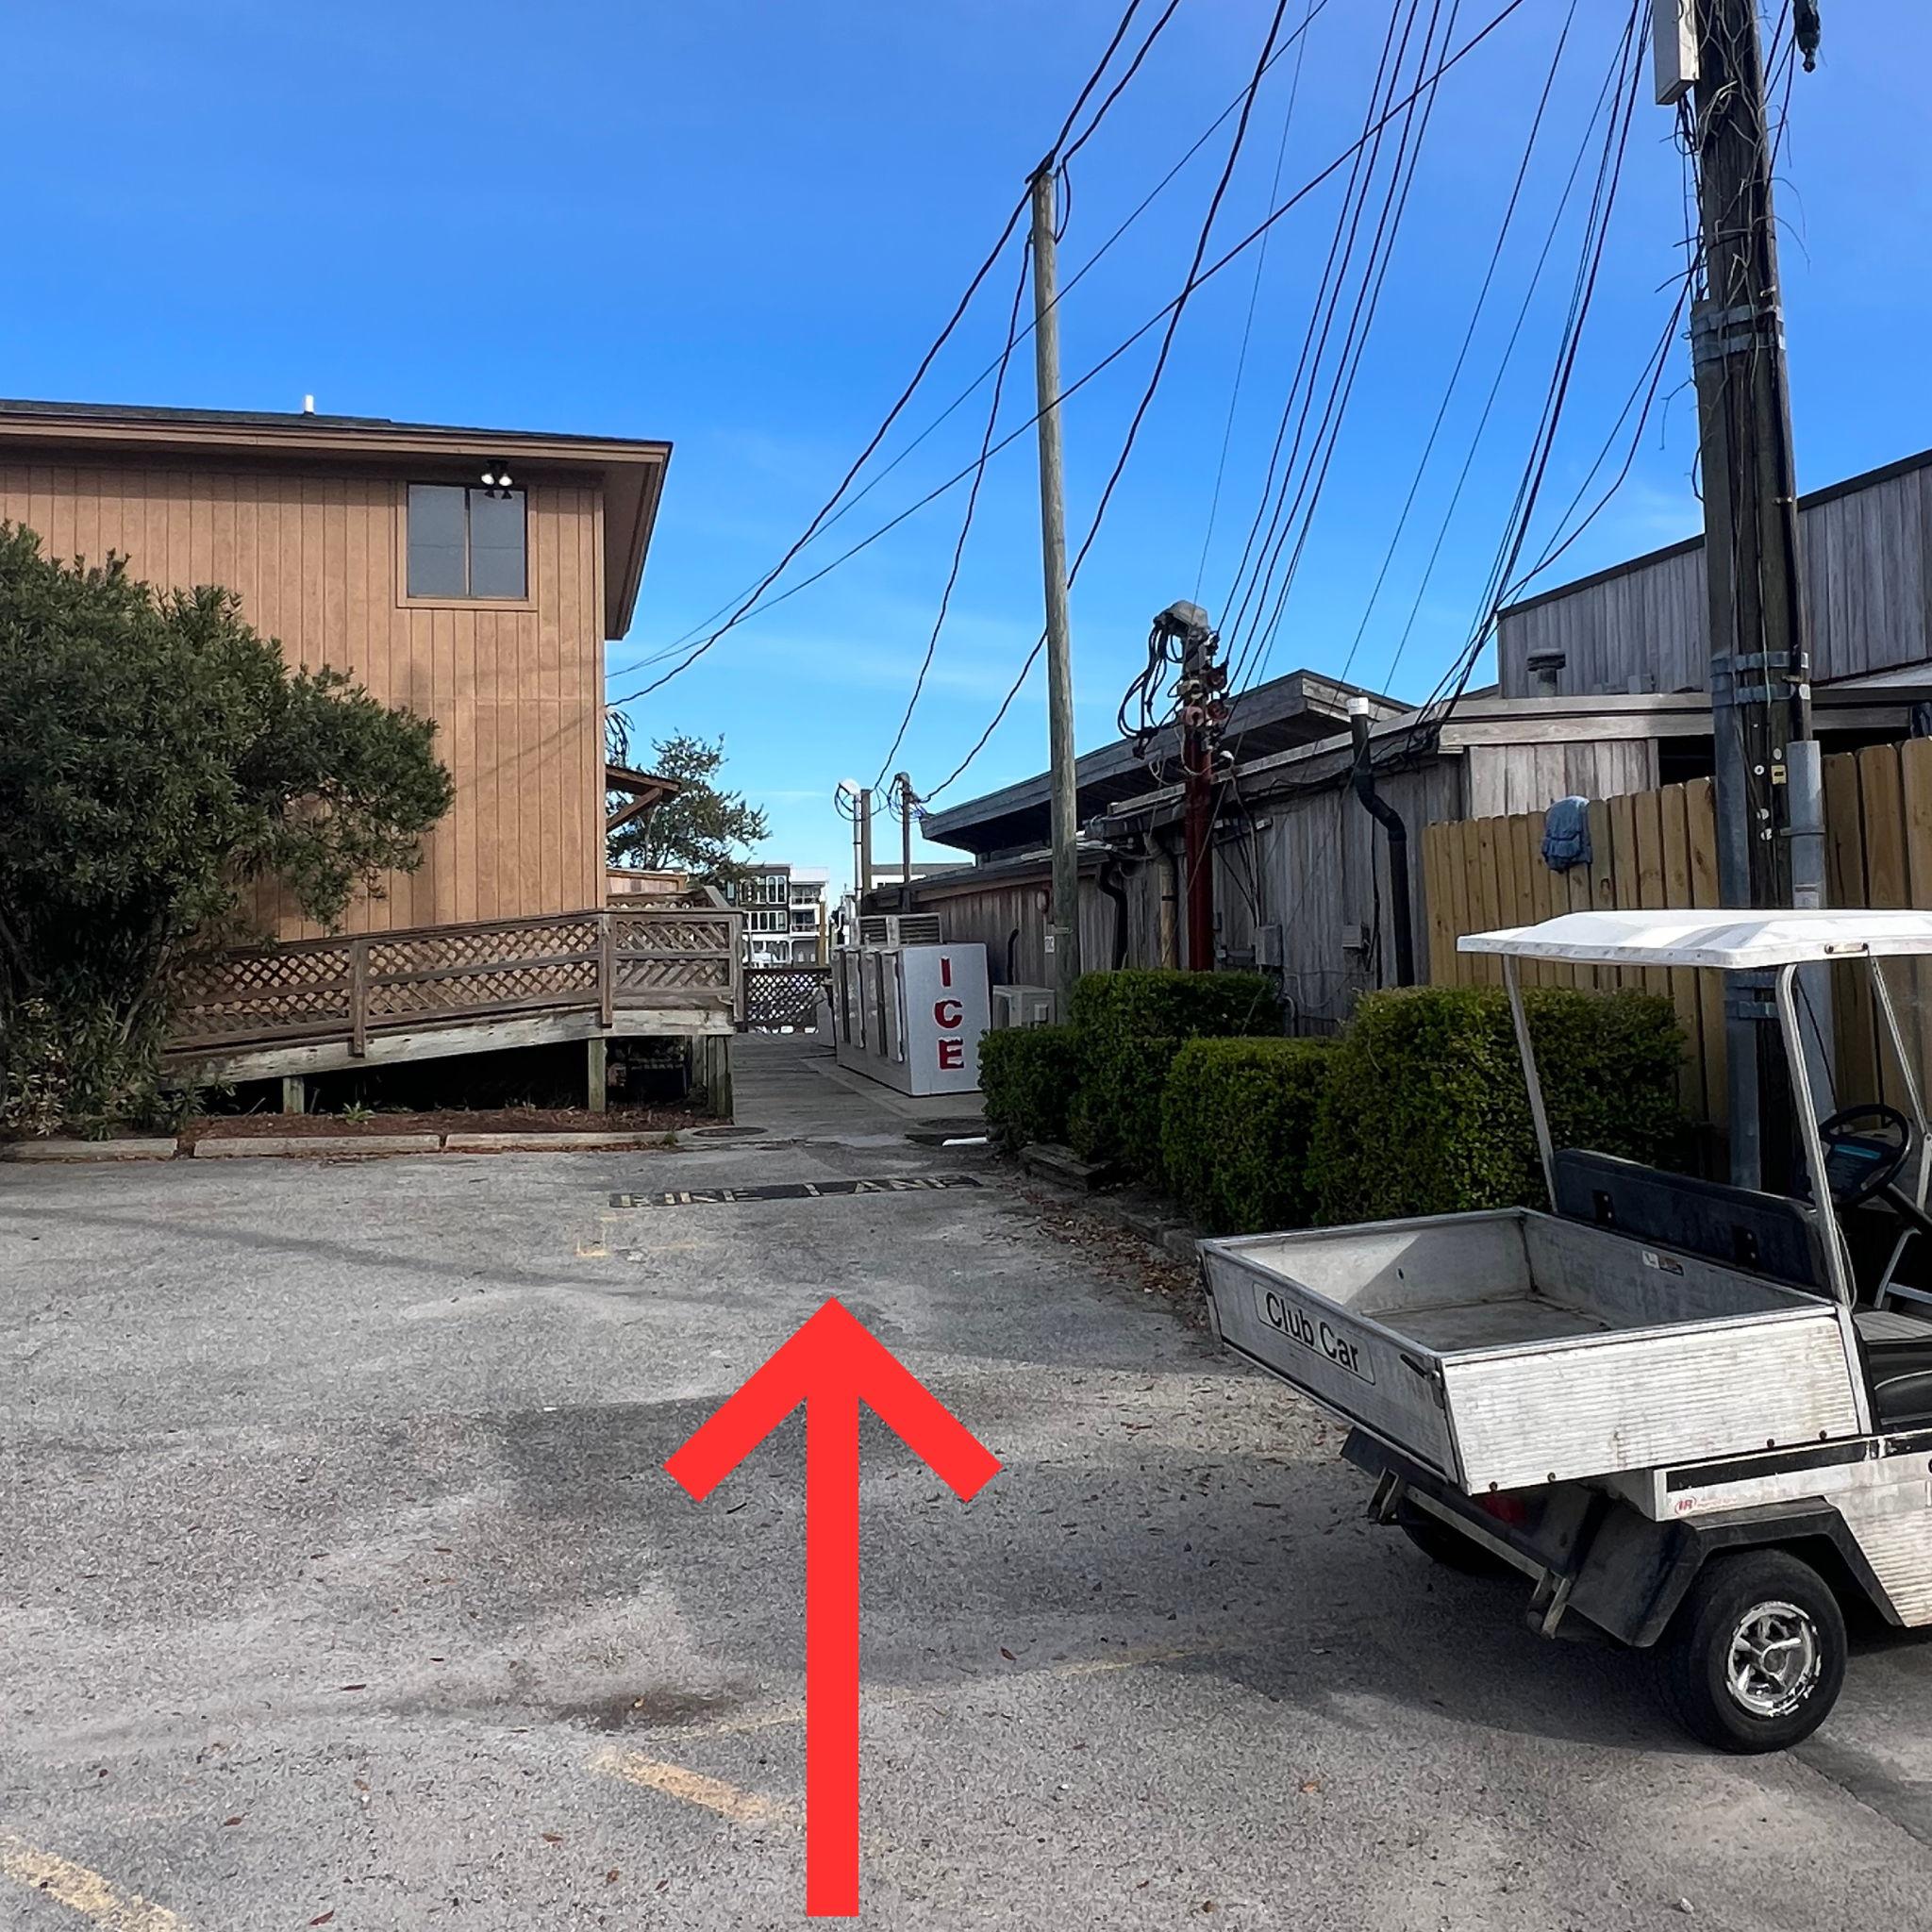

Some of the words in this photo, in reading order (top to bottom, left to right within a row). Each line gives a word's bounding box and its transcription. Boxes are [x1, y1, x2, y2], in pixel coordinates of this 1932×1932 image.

[934, 957, 965, 1070] ICE
[620, 1189, 763, 1208] FIRE
[805, 1176, 979, 1196] LANE
[1266, 1291, 1314, 1347] Club
[1320, 1322, 1358, 1373] Car
